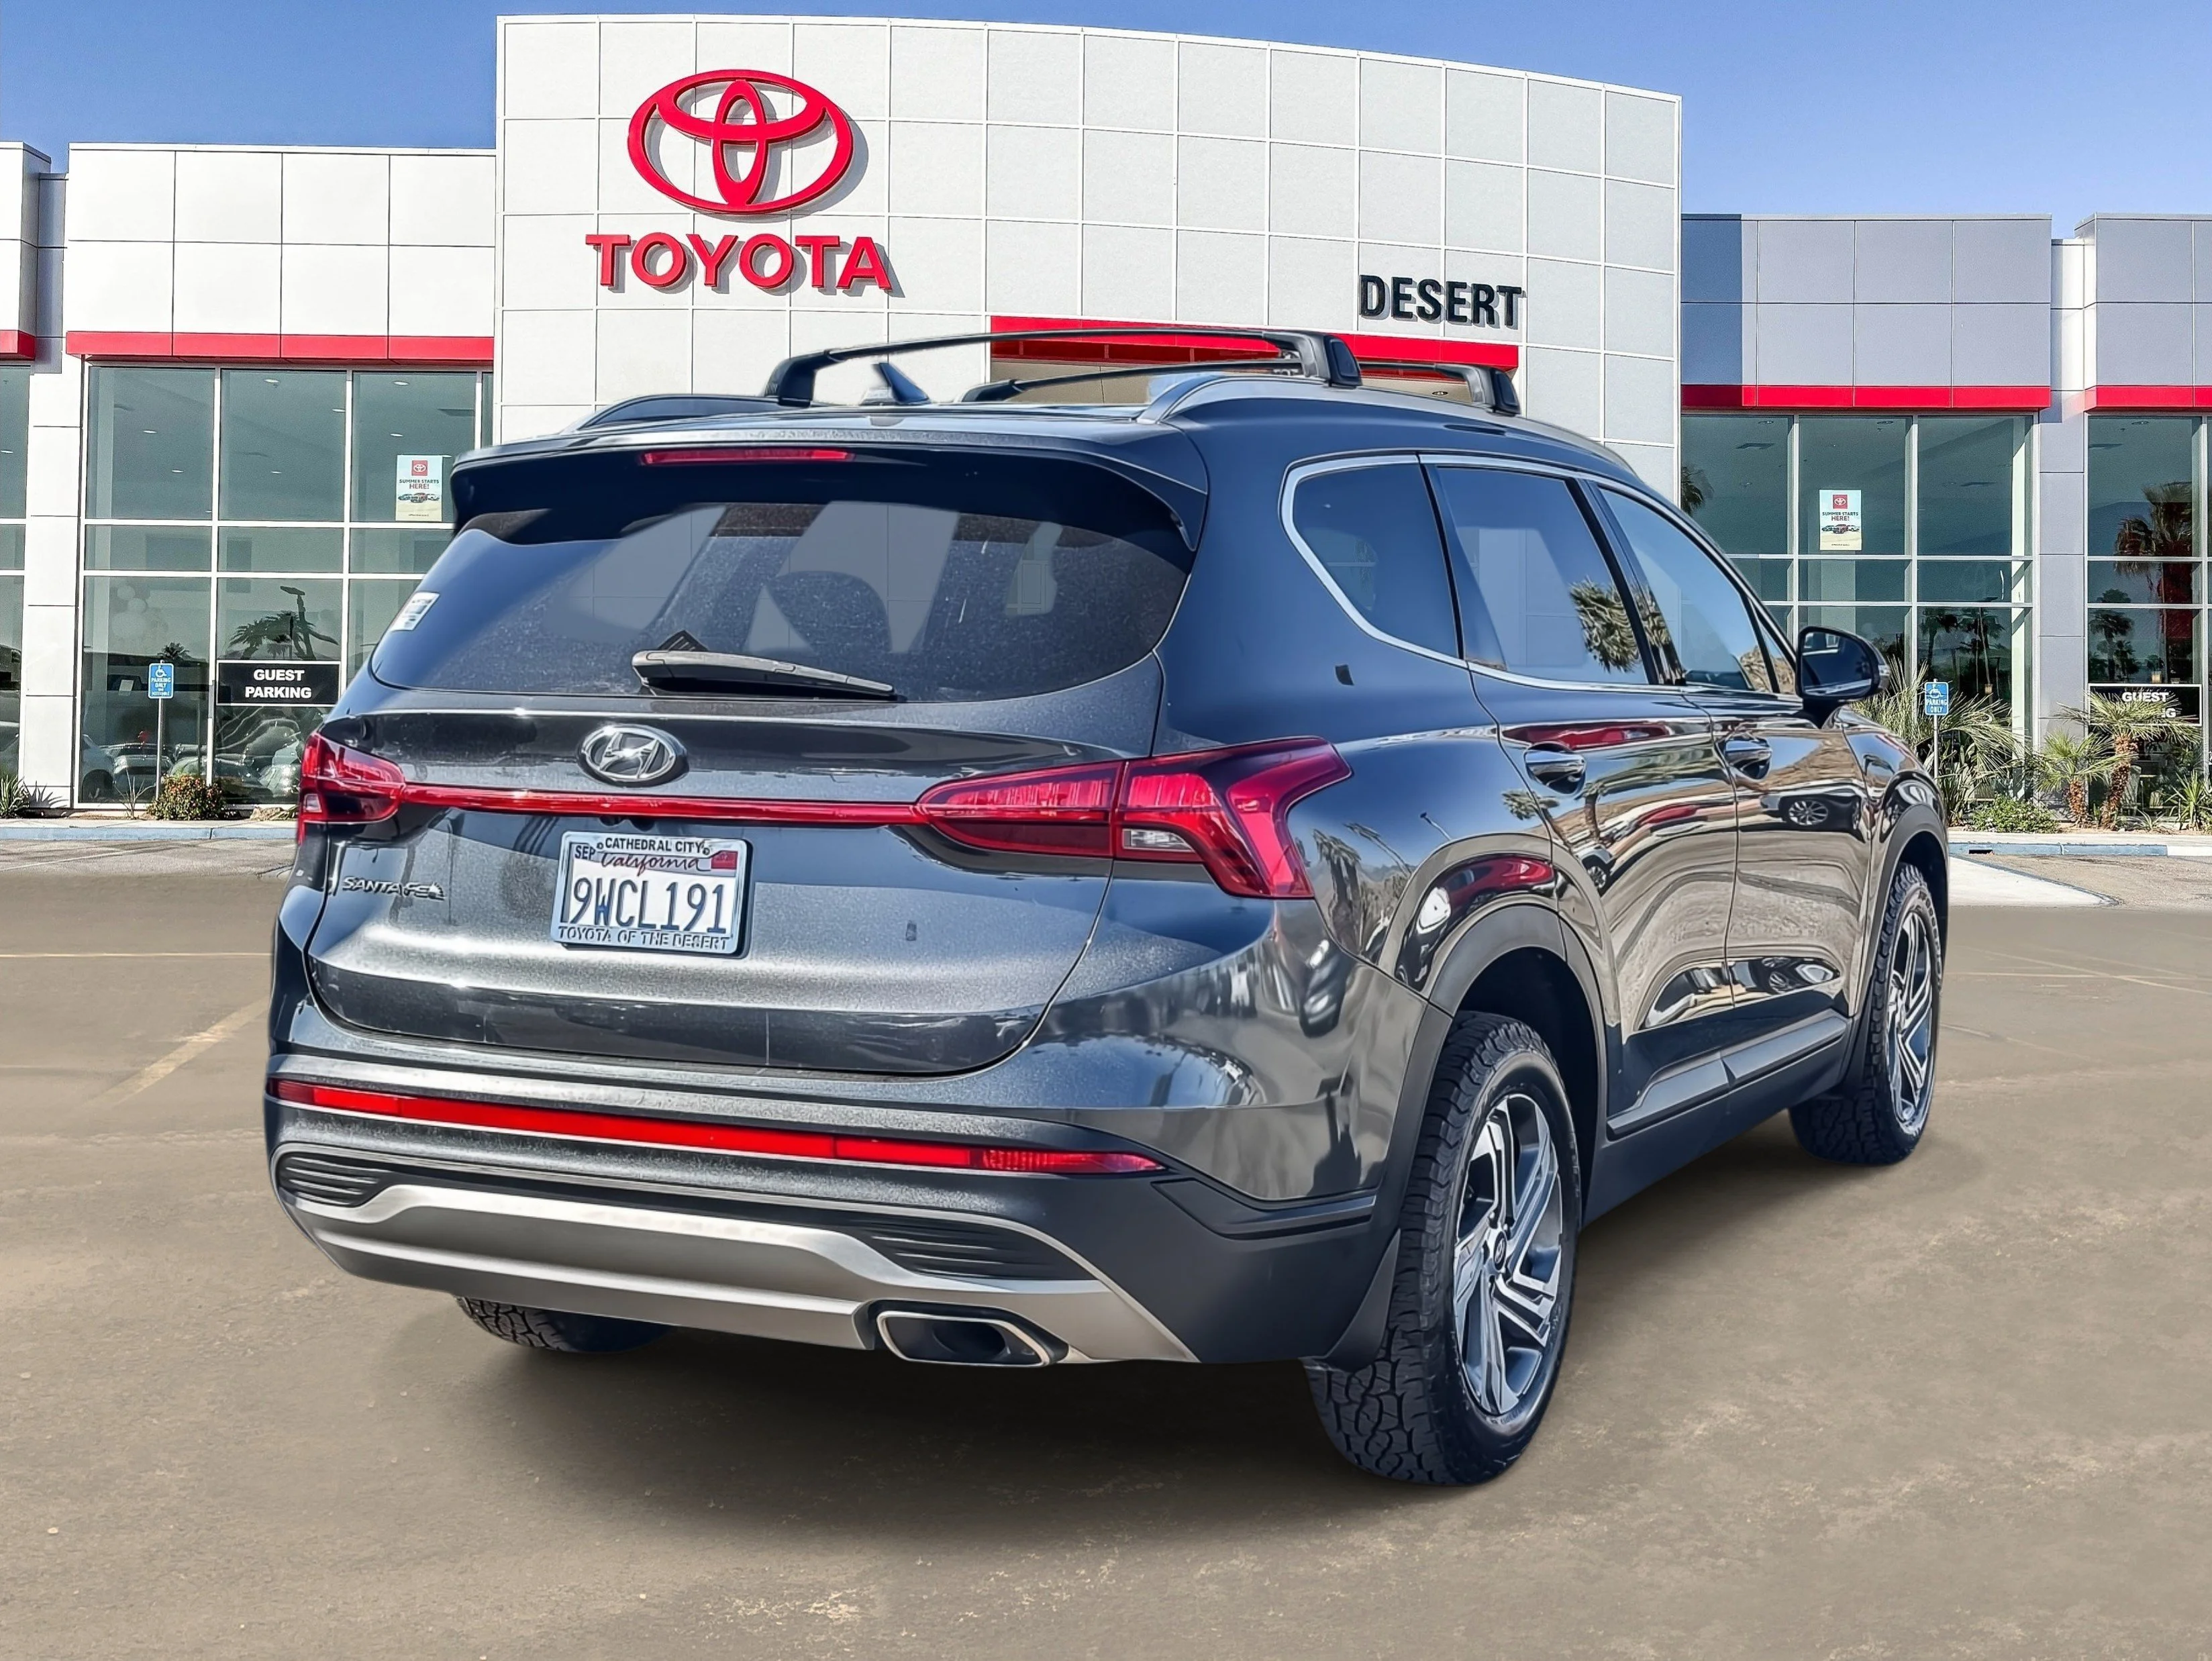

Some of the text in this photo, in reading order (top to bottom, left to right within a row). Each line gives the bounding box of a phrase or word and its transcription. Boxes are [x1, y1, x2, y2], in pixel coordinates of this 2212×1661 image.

[585, 232, 892, 290] TOYOTA
[1359, 274, 1522, 326] DESERT
[253, 669, 305, 681] GUEST
[245, 686, 312, 699] PARKING
[574, 844, 596, 860] SEP
[605, 837, 703, 854] CATHEDRAL CITY
[601, 852, 711, 876] California
[342, 876, 403, 897] SANTA
[569, 876, 726, 934] 9WCL191
[558, 925, 730, 951] TOYOTA OF THE DESERT
